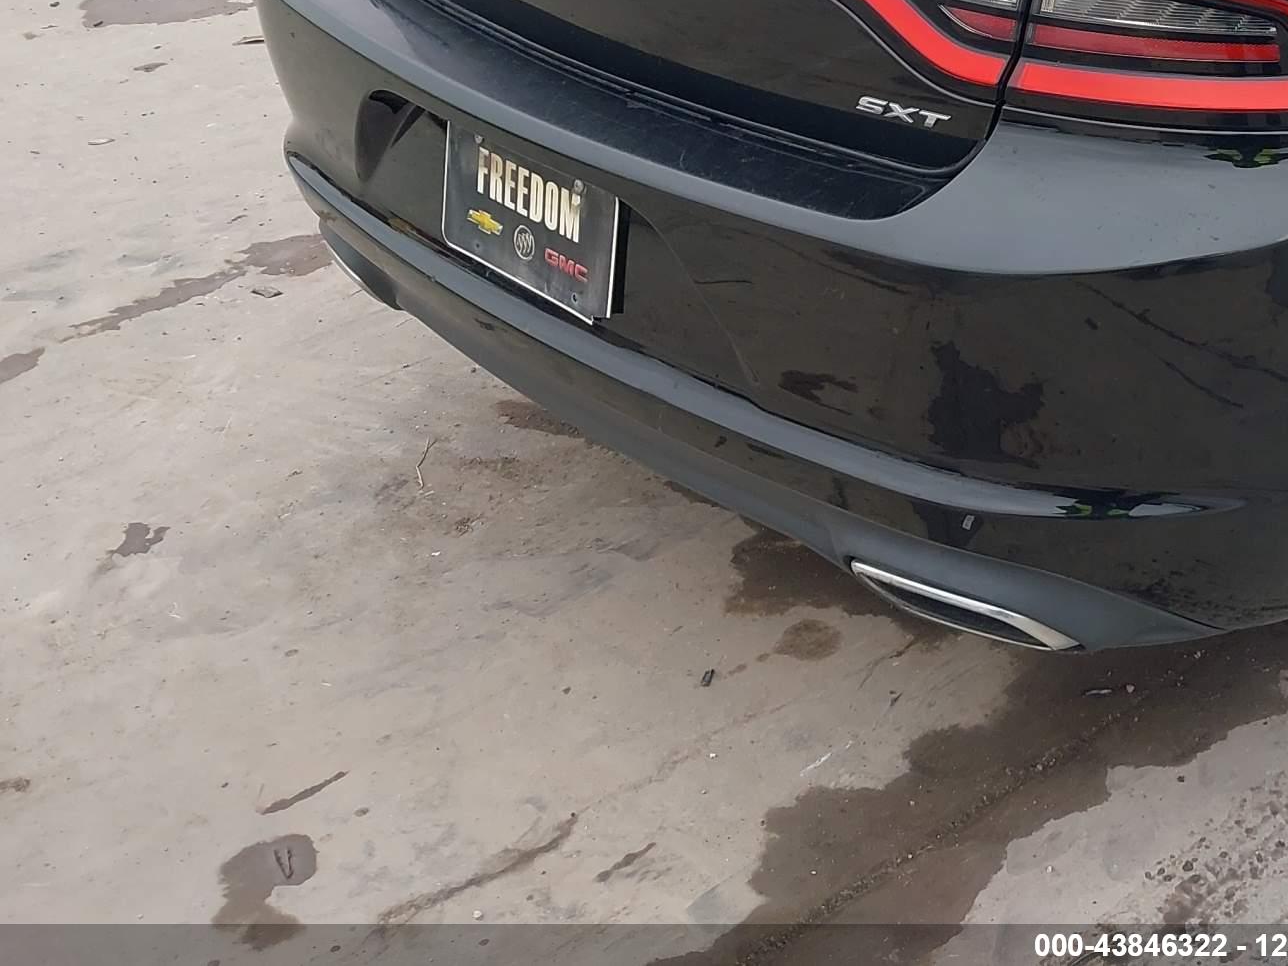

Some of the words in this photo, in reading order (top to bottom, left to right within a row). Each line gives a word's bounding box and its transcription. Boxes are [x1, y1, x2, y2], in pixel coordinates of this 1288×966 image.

[856, 96, 952, 128] SXT
[477, 146, 581, 243] FREEDOM
[544, 248, 589, 283] GMC
